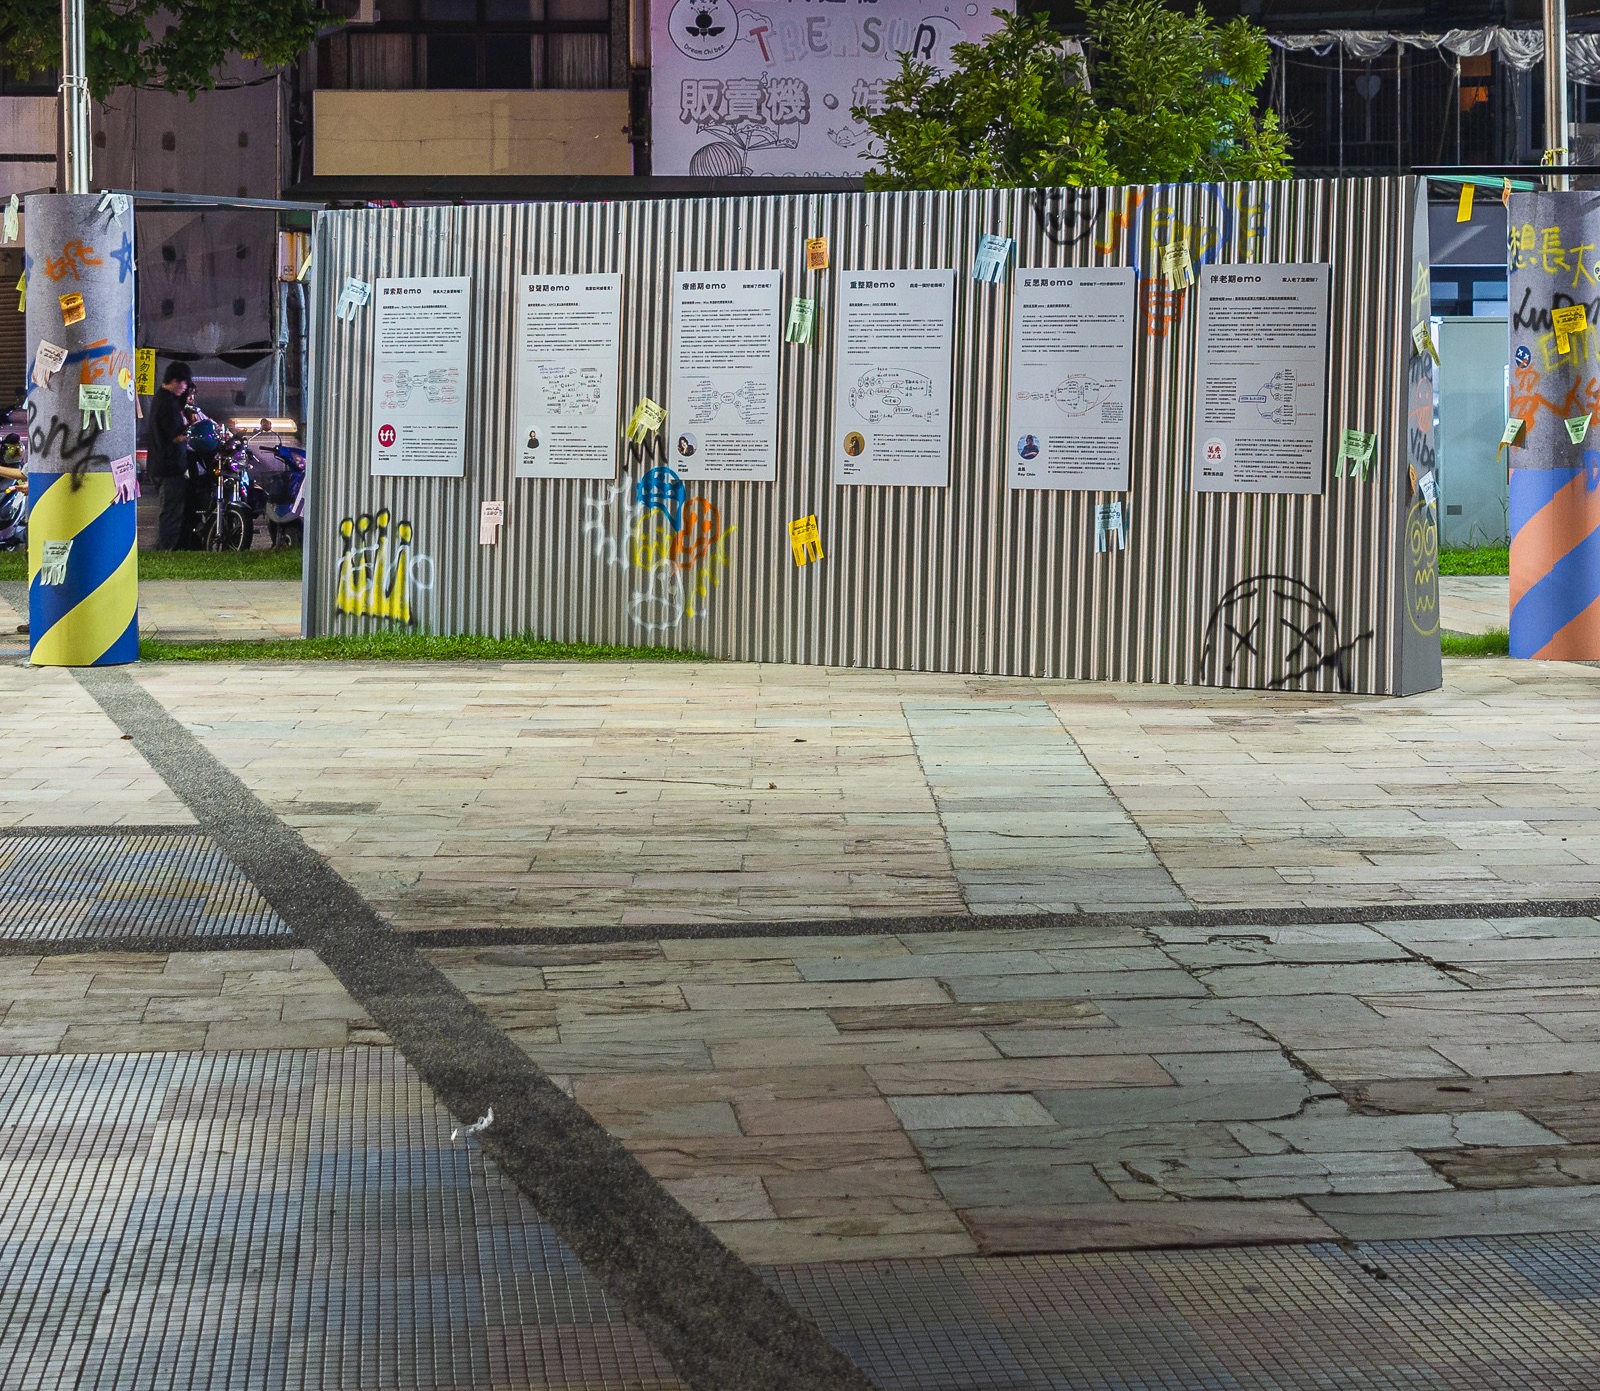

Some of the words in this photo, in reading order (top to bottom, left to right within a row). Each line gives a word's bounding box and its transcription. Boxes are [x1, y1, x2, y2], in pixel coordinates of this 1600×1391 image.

[138, 349, 154, 395] 請勿停車
[379, 429, 394, 442] tft
